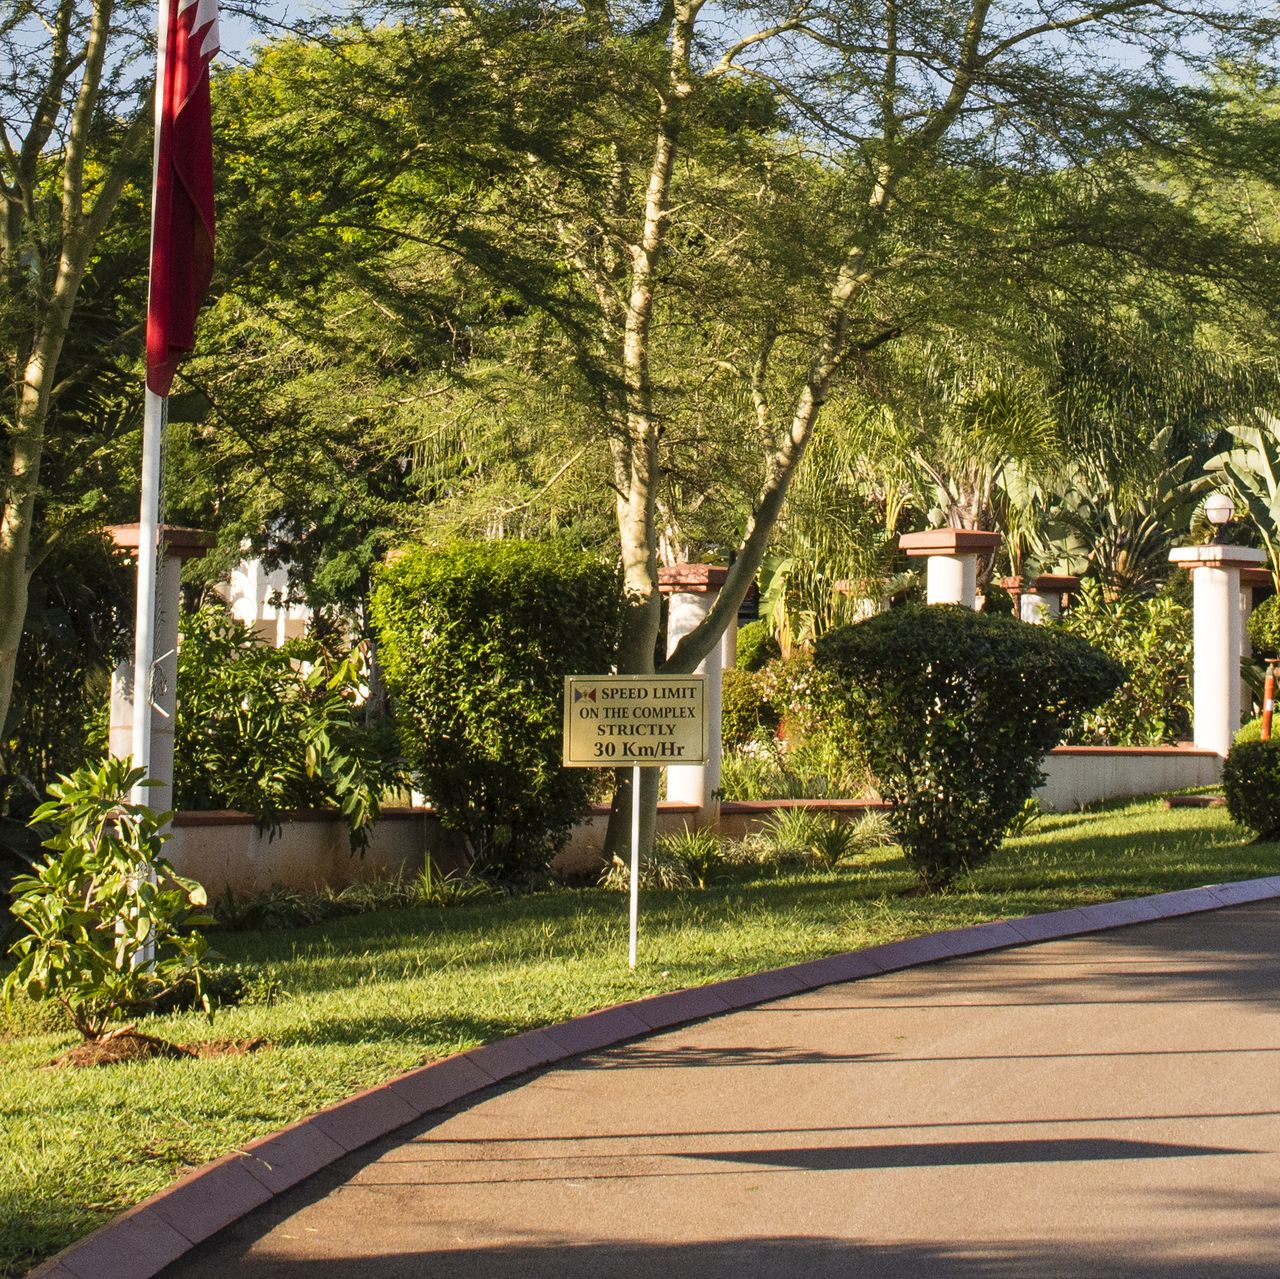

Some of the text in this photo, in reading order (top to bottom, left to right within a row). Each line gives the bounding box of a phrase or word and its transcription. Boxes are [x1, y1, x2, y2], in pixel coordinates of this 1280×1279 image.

[601, 687, 697, 700] SPEED LIMIT
[579, 706, 696, 719] ON THE COMPLEX
[597, 724, 676, 736] STRICTLY
[593, 741, 685, 758] 30 Km/Hr
